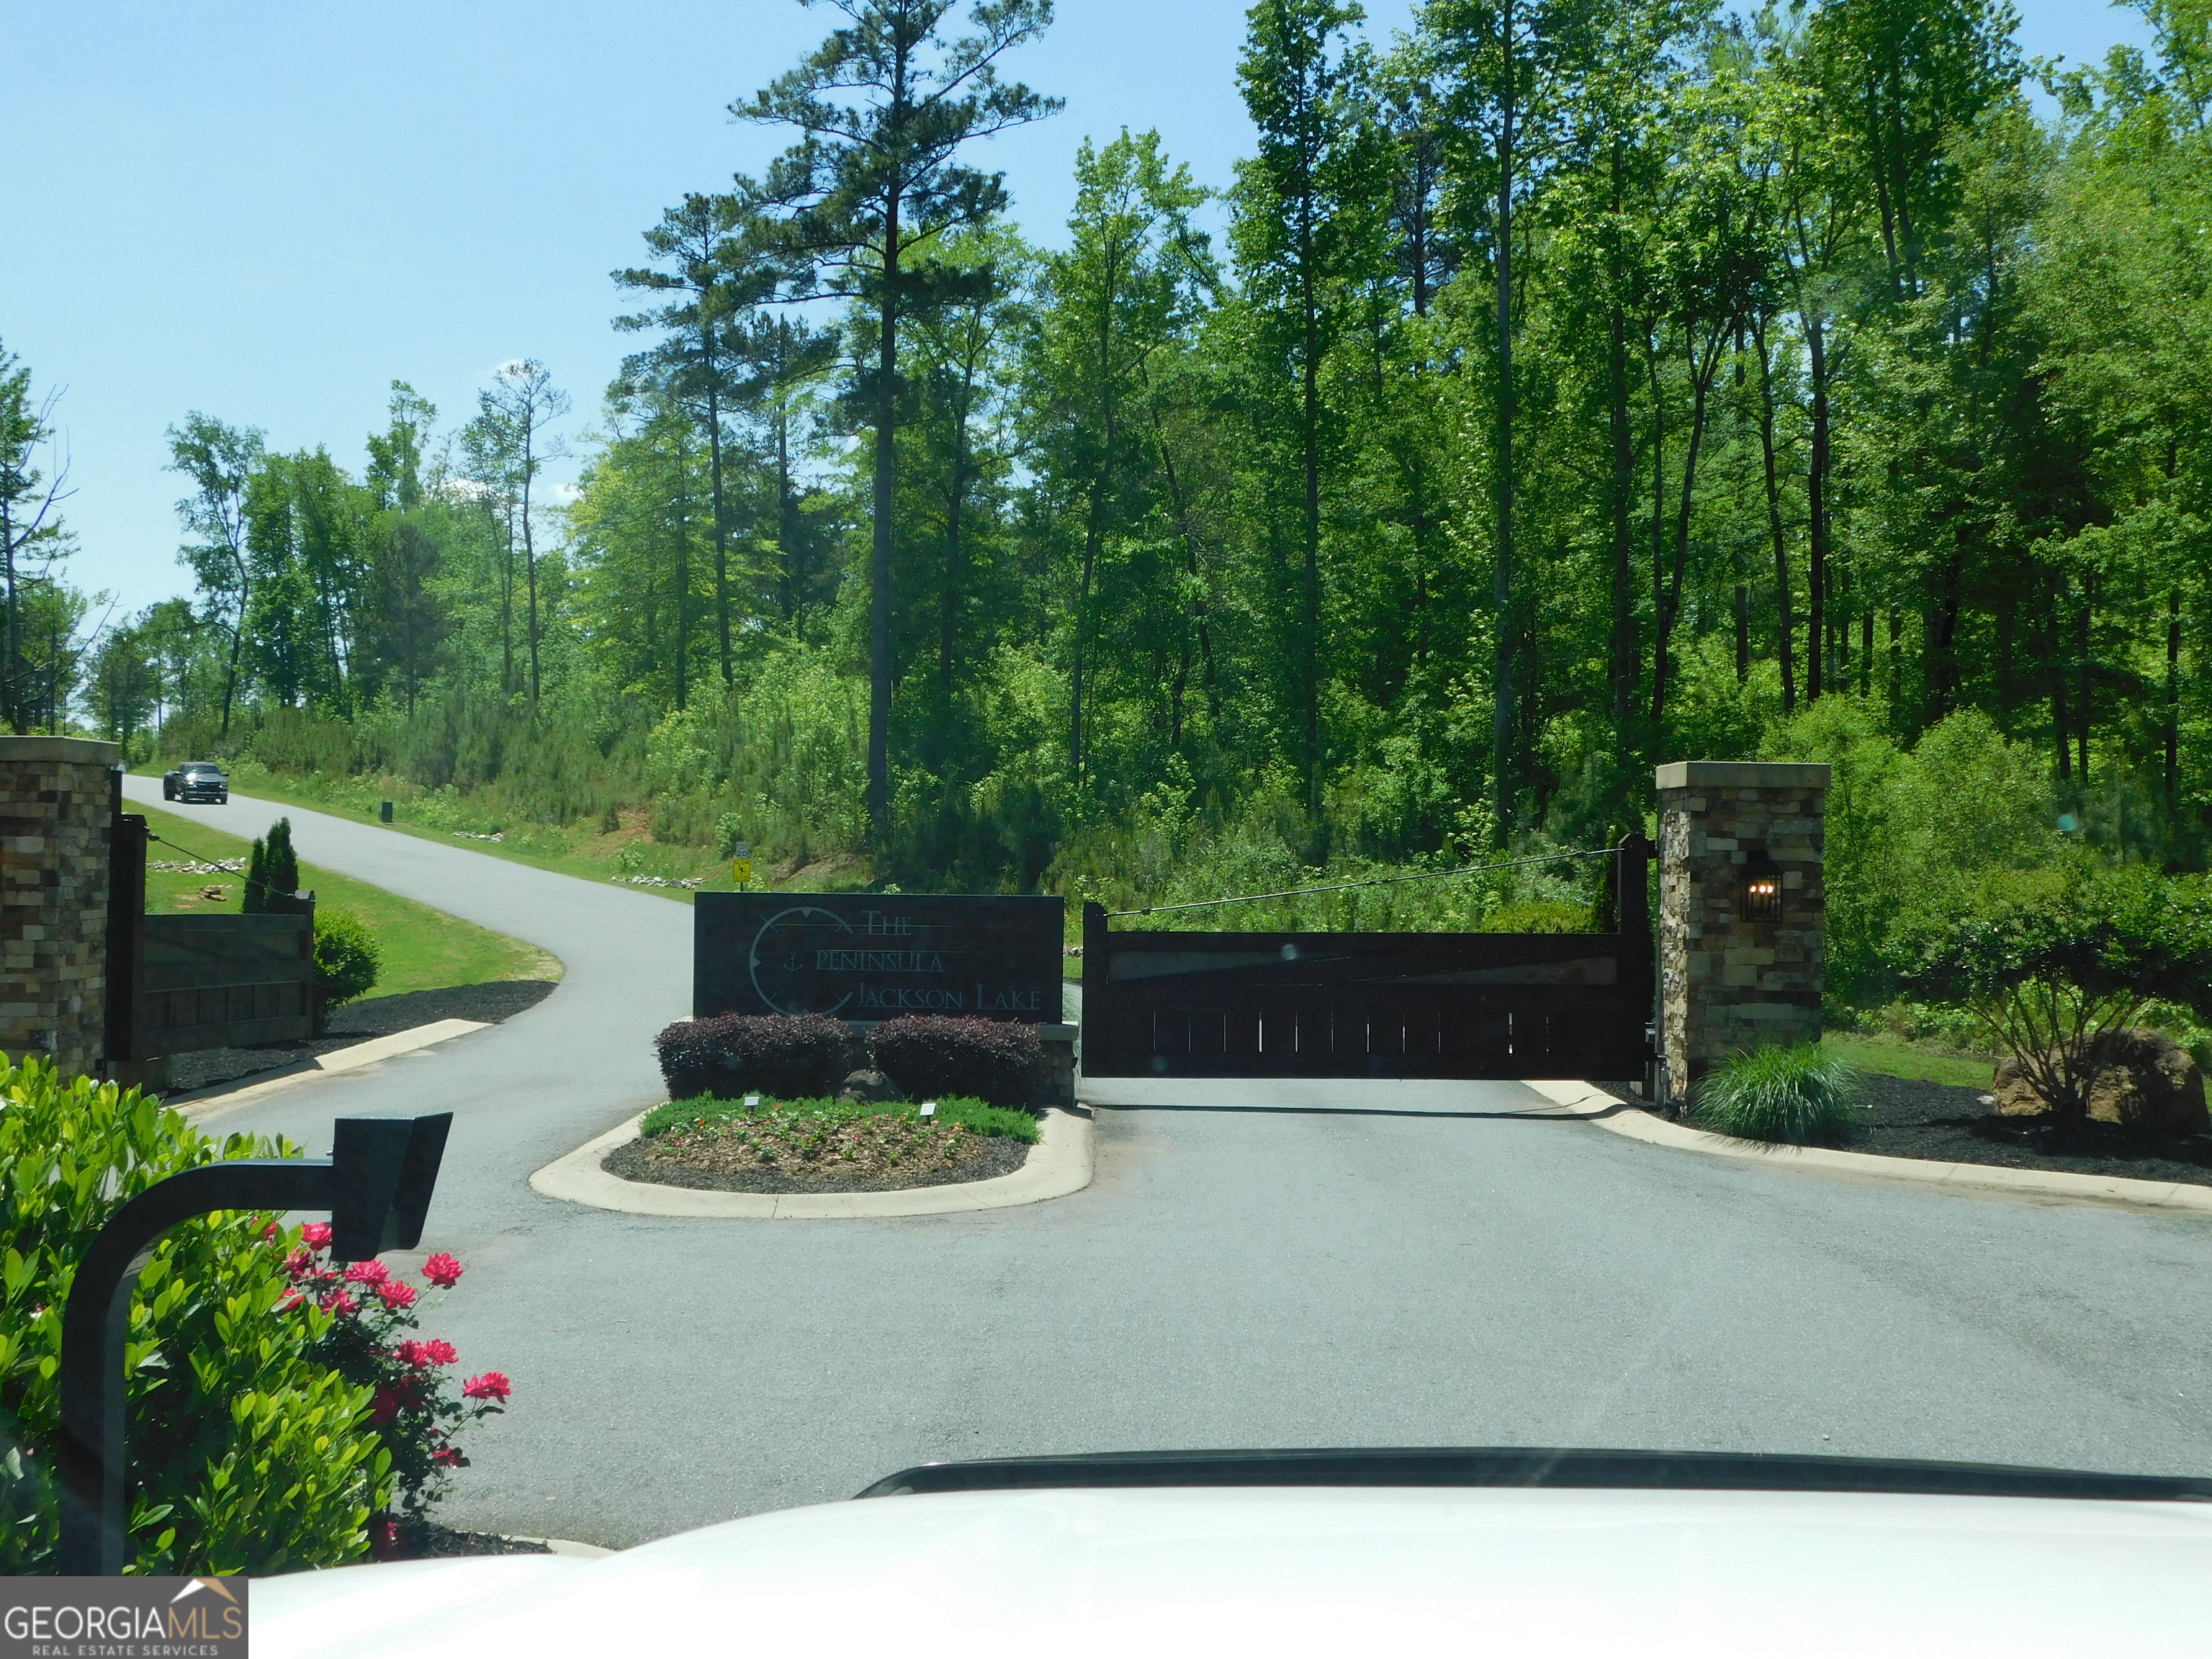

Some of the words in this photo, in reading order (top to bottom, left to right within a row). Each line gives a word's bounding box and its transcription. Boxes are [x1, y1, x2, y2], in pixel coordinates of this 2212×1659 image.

[860, 910, 912, 936] THE
[816, 950, 945, 973] PENINSULA
[858, 982, 963, 1009] JACKSON
[976, 984, 1040, 1010] LAKE
